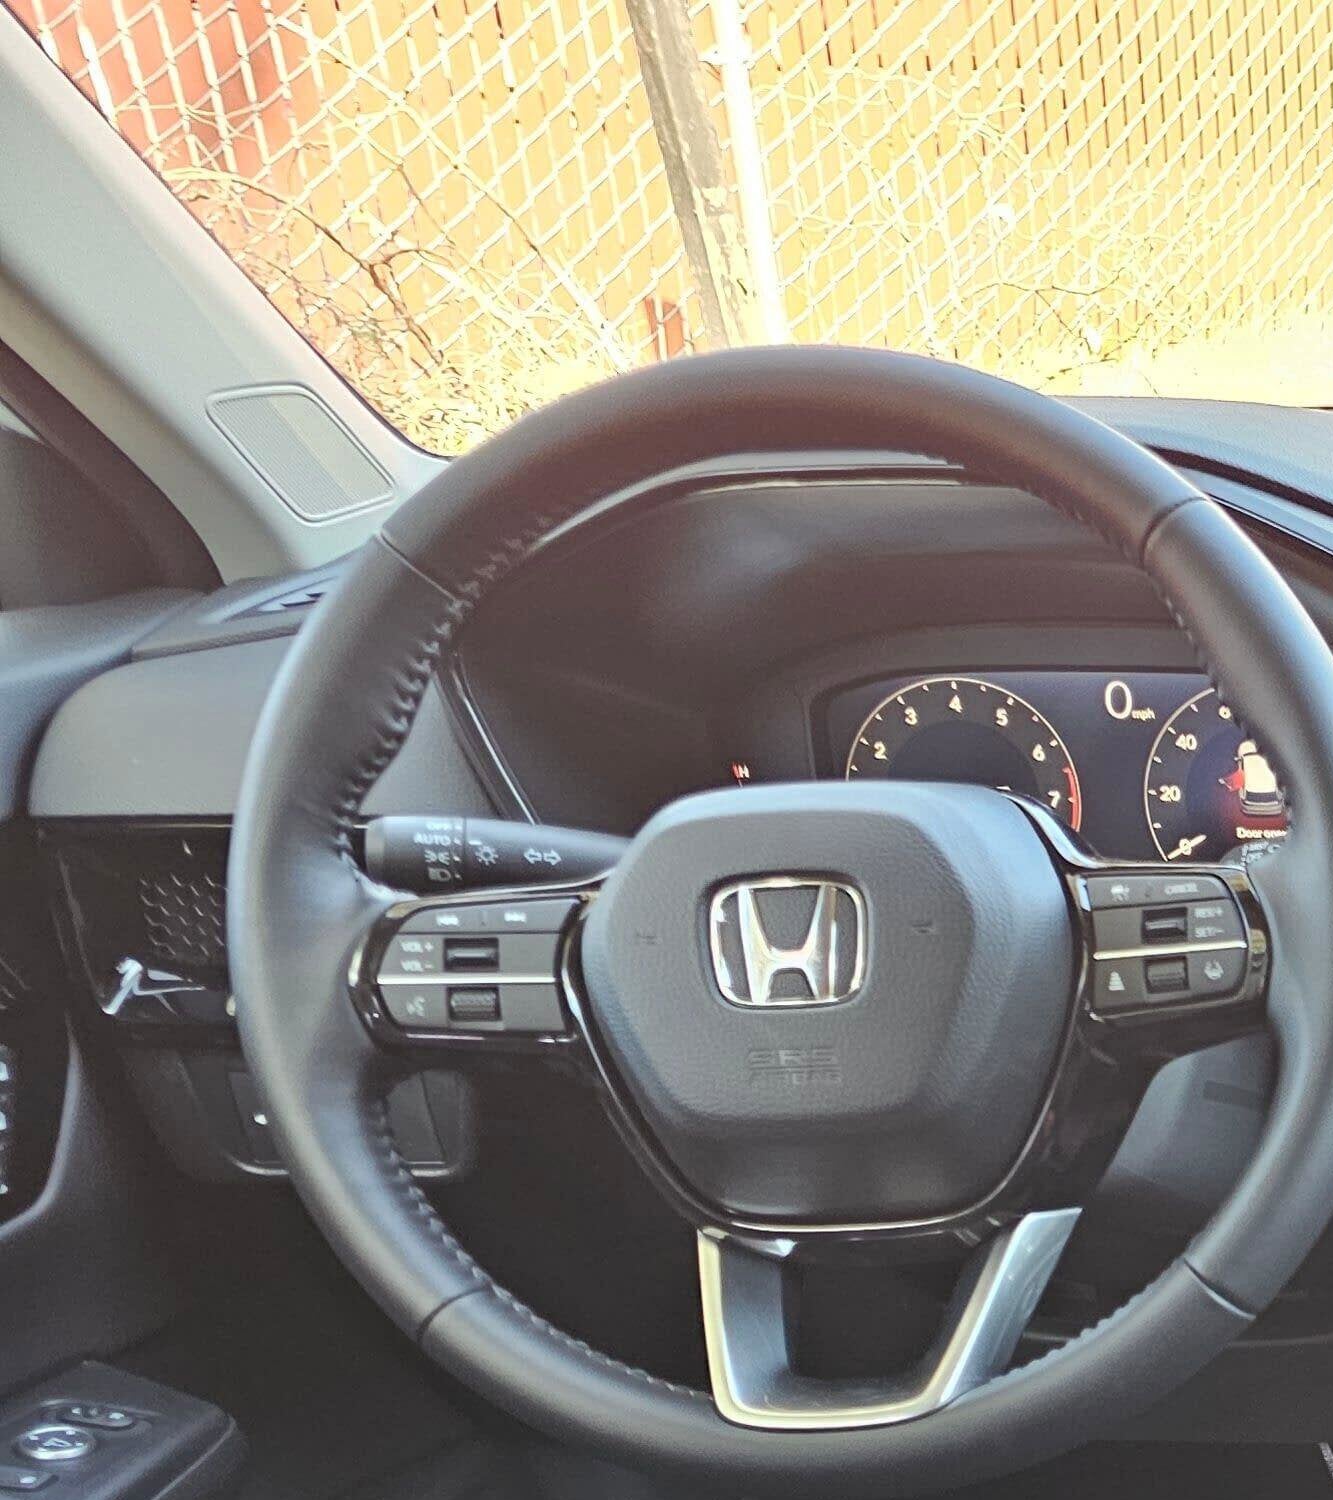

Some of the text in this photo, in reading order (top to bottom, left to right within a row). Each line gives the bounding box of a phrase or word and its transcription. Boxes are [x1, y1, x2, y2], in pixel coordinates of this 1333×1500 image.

[949, 695, 963, 713] 4
[1104, 680, 1156, 722] 0 mph
[904, 708, 918, 726] 3
[996, 708, 1009, 726] 5
[873, 742, 888, 760] 2
[1175, 734, 1198, 752] 40
[1031, 744, 1046, 762] 6
[1047, 791, 1061, 808] 7
[1159, 785, 1181, 802] 20
[414, 832, 451, 846] AUTO
